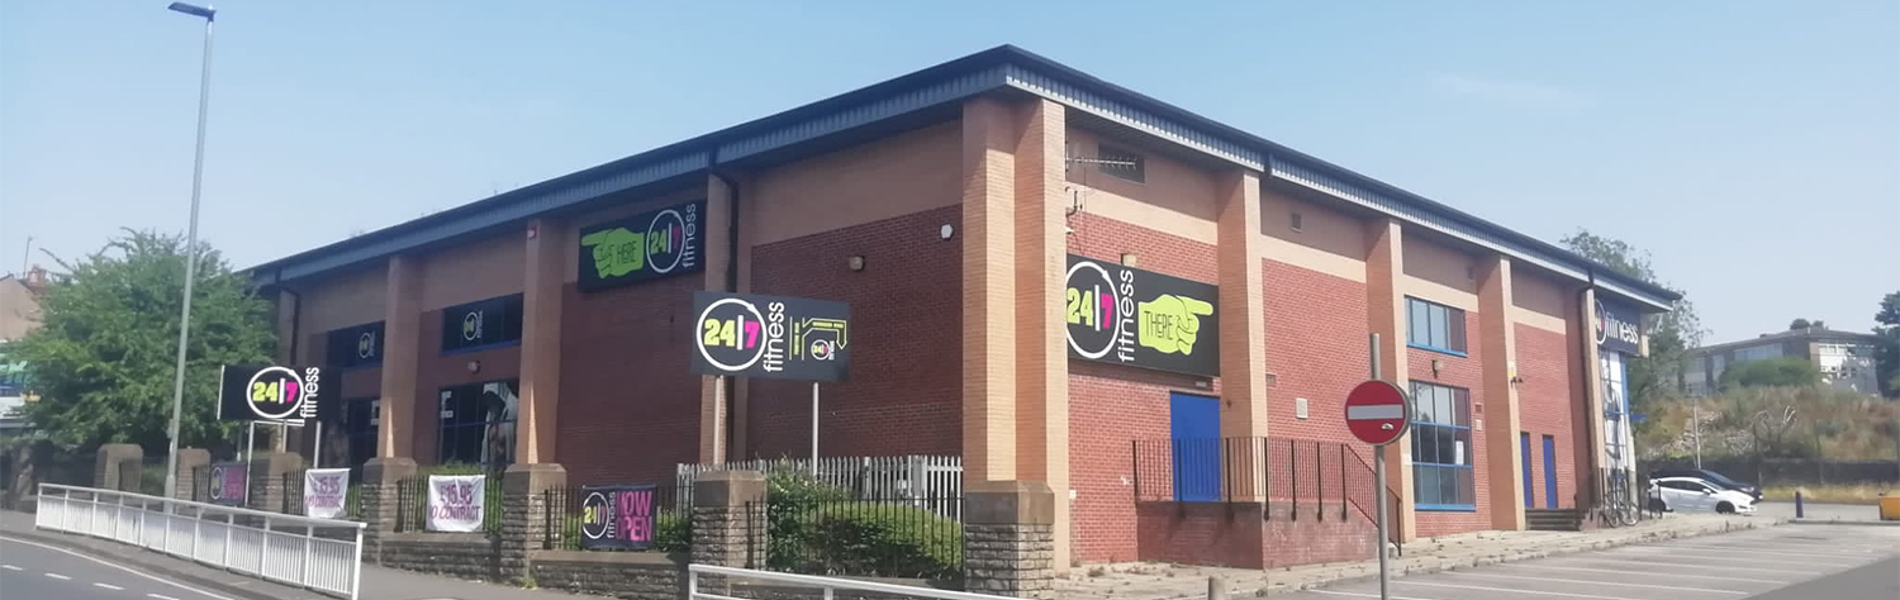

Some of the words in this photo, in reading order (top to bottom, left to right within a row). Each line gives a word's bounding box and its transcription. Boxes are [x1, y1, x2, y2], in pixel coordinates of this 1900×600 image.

[682, 203, 696, 268] fitness
[1118, 269, 1135, 362] fitness
[1143, 310, 1174, 340] THERE
[1605, 311, 1639, 344] fitness
[763, 302, 785, 372] fitness
[300, 367, 320, 418] fitness
[616, 491, 653, 516] NOW
[615, 516, 653, 541] OPEN
